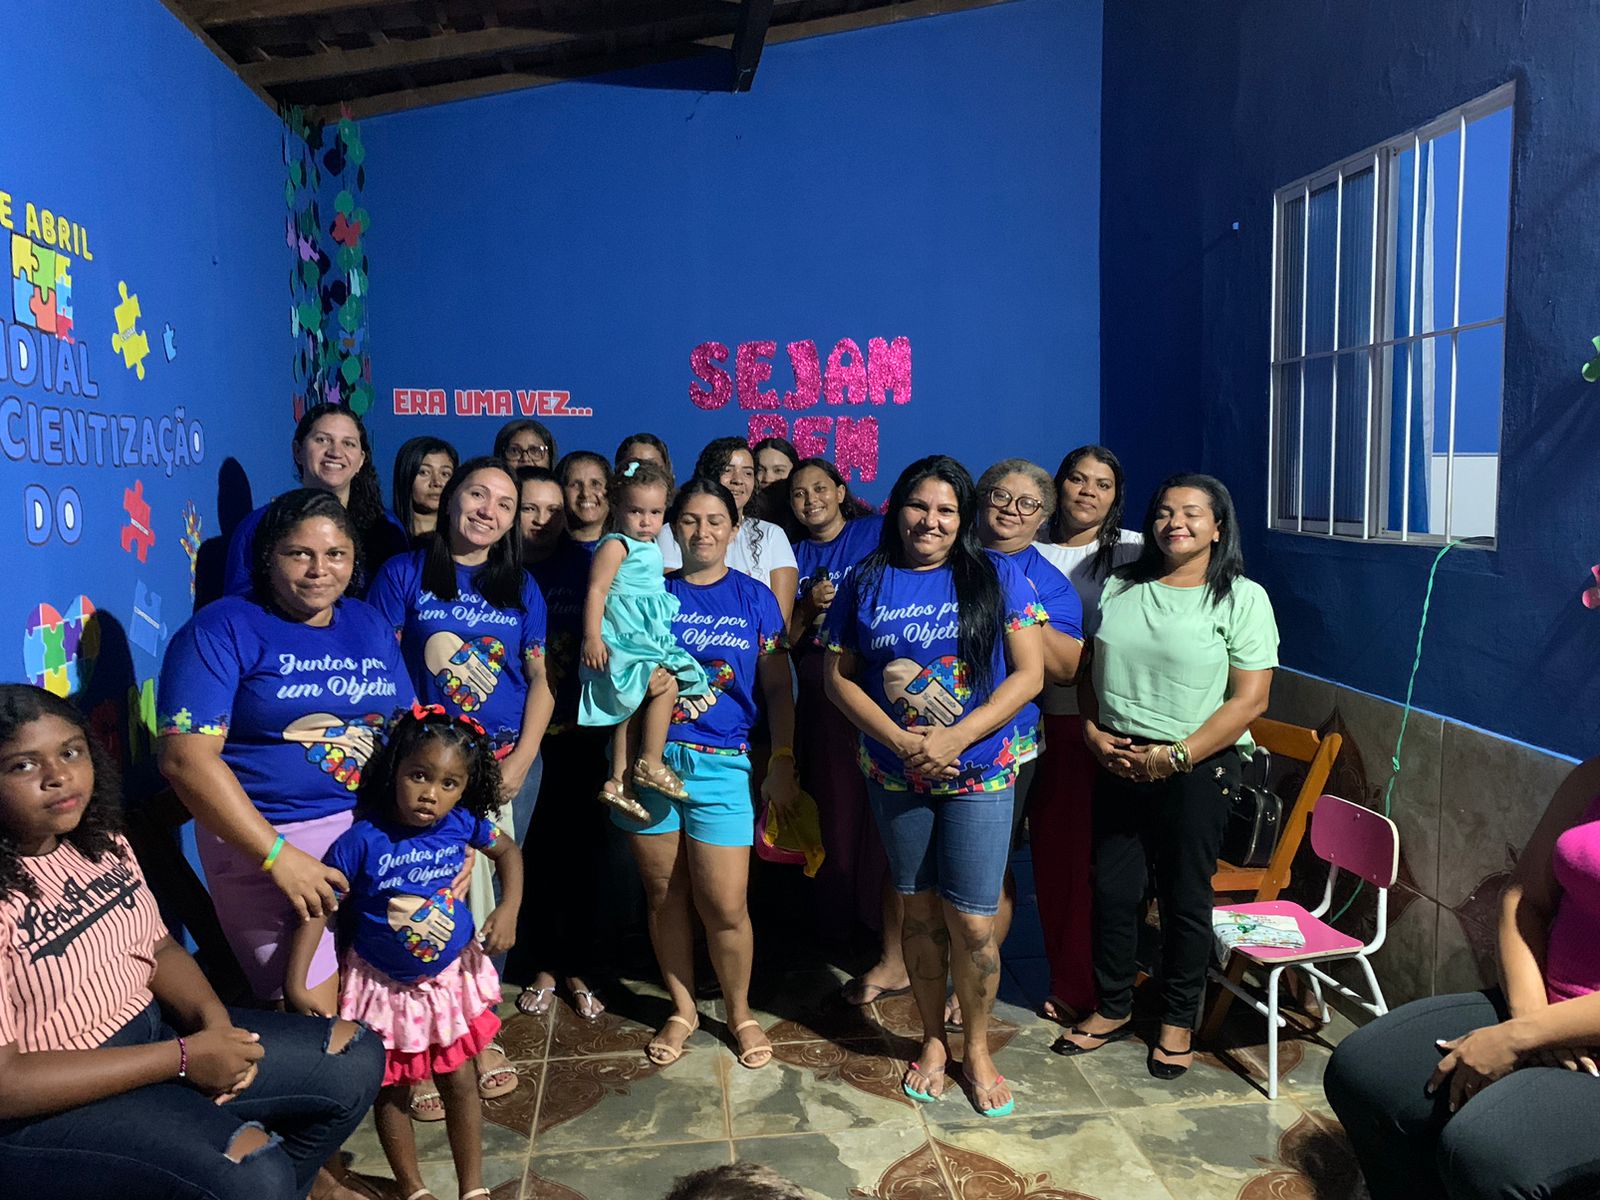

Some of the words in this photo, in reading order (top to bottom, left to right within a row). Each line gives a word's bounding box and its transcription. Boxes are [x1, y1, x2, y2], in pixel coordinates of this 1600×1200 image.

[26, 202, 93, 261] ABRIL
[0, 318, 99, 399] DIAL
[688, 335, 912, 410] SEJAM
[394, 388, 446, 416] ERA
[455, 389, 513, 416] UMA
[516, 389, 593, 416] VEZ...
[24, 484, 82, 545] DO
[451, 605, 518, 628] Objetivo
[671, 612, 715, 624] untos
[713, 615, 748, 630] por
[871, 603, 936, 629] Juntos
[682, 628, 750, 652] Objetivo
[871, 633, 899, 650] um
[903, 621, 960, 649] Objeti
[279, 653, 358, 675] Juntos
[276, 683, 324, 699] um
[378, 847, 433, 876] Juntos
